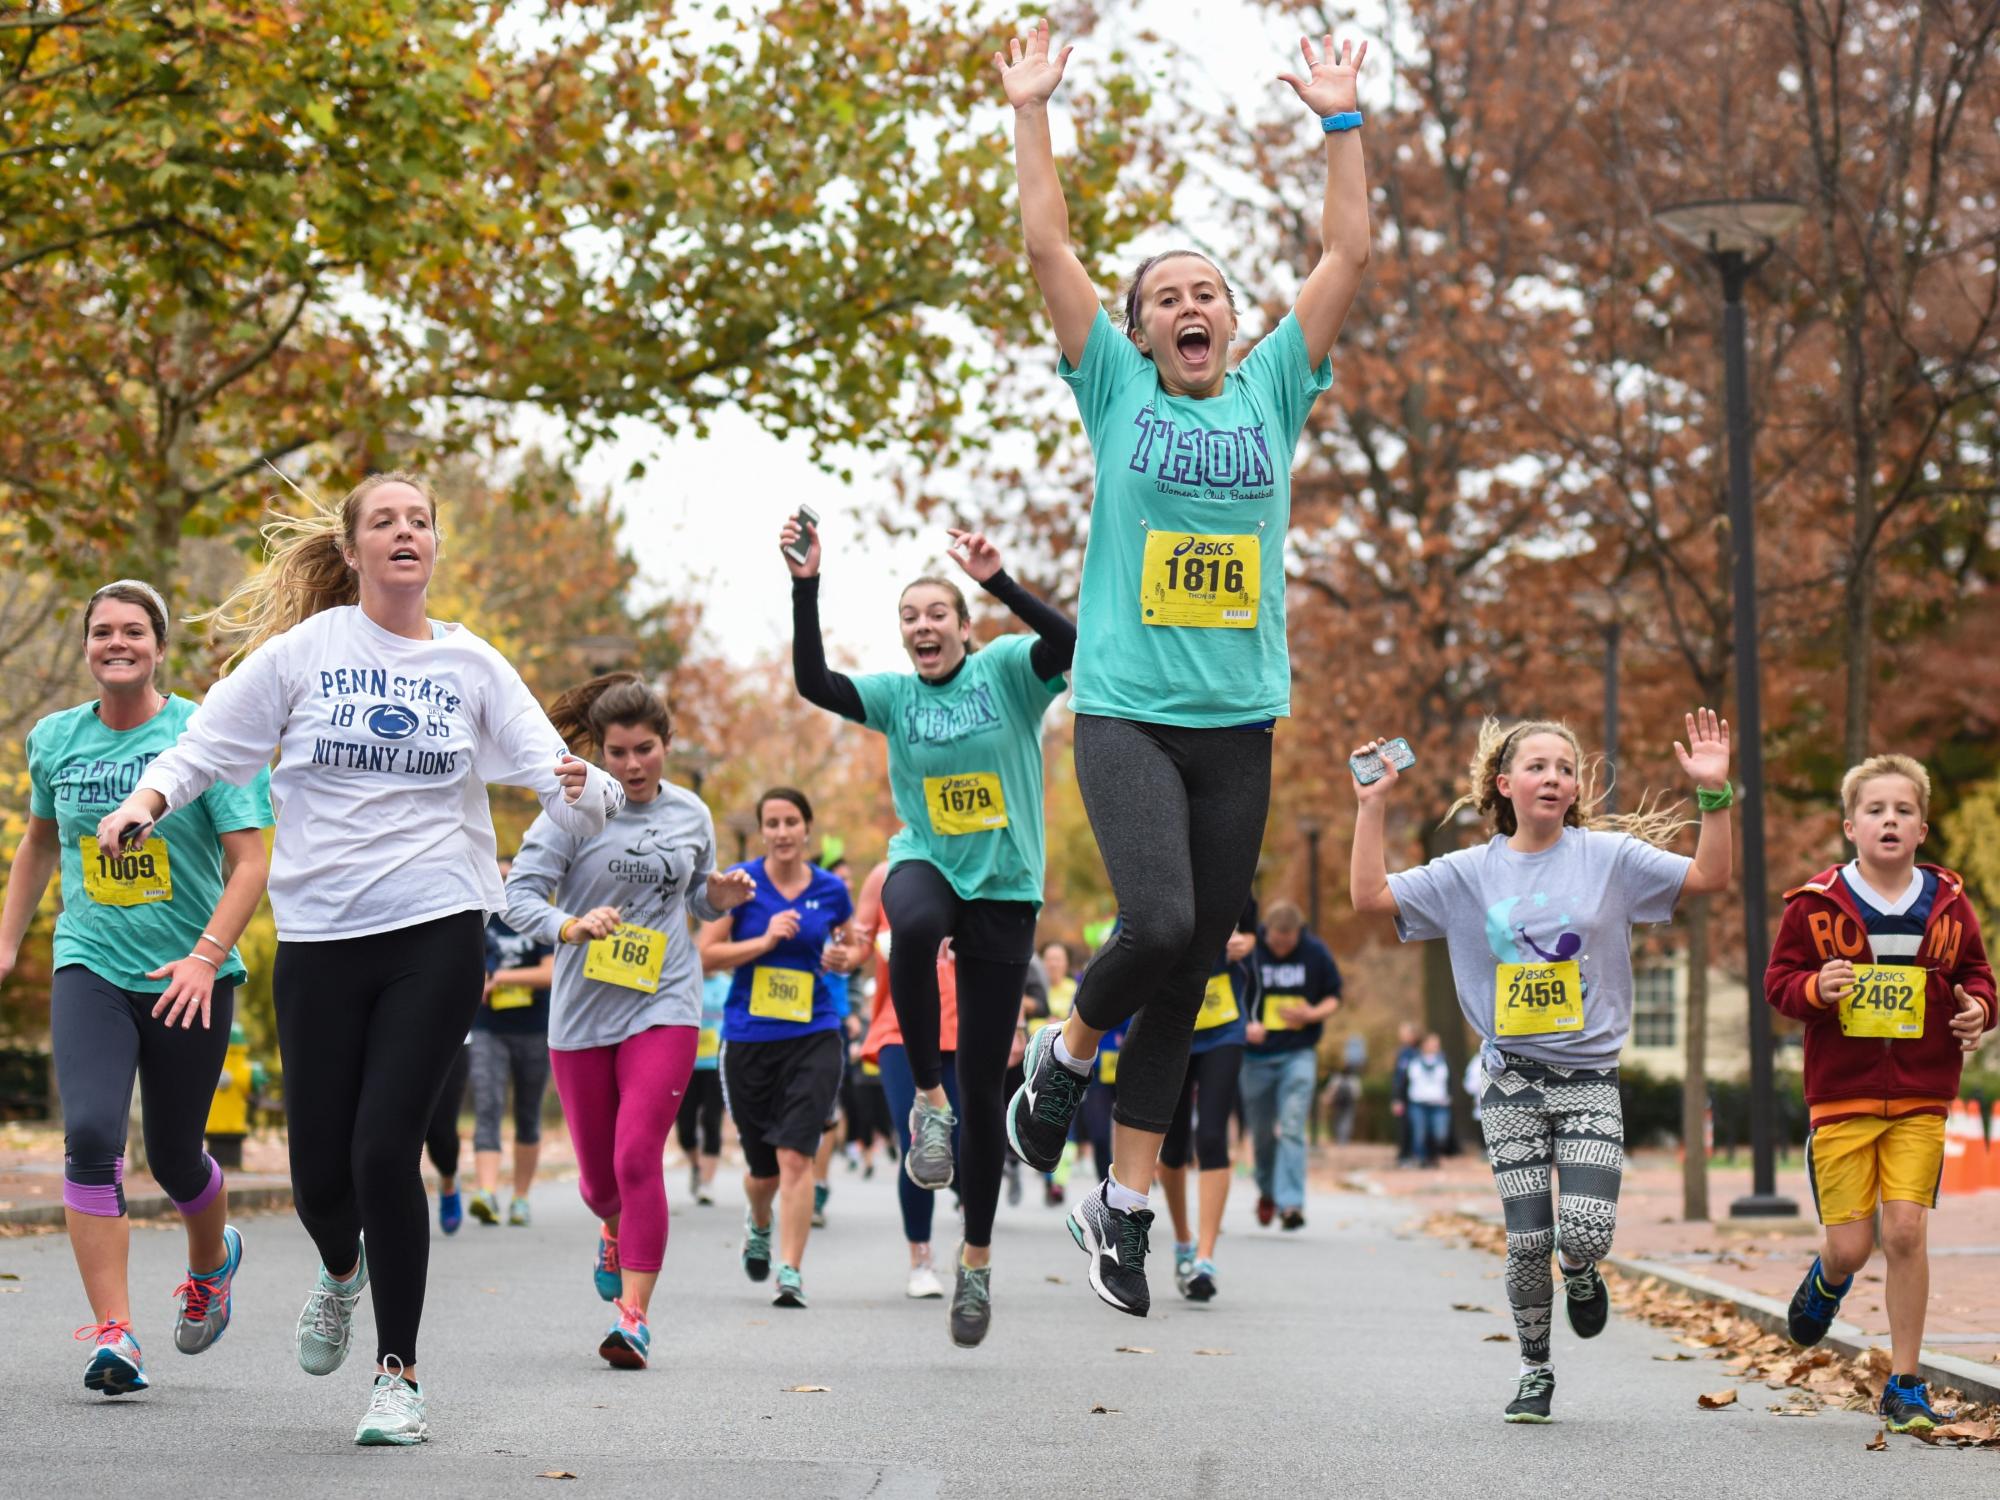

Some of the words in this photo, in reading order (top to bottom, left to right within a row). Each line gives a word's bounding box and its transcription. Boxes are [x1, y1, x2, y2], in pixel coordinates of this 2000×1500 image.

[1129, 407, 1274, 487] THON
[1154, 481, 1199, 498] Women's
[1204, 488, 1225, 500] Club
[1230, 488, 1274, 500] Basketball
[1165, 557, 1243, 593] 1816
[320, 668, 387, 698] PENN
[393, 676, 461, 713] STATE
[330, 704, 355, 727] 18
[426, 714, 450, 738] 55
[312, 738, 399, 772] NITTANY
[405, 749, 458, 776] LIONS
[61, 752, 158, 803] THO
[939, 788, 991, 813] 1679
[96, 854, 155, 881] 1009
[608, 859, 649, 874] Girls
[628, 874, 658, 884] run
[612, 940, 649, 966] 168
[768, 982, 798, 1002] 390
[1508, 980, 1567, 1008] 2459
[1851, 984, 1913, 1011] 2462
